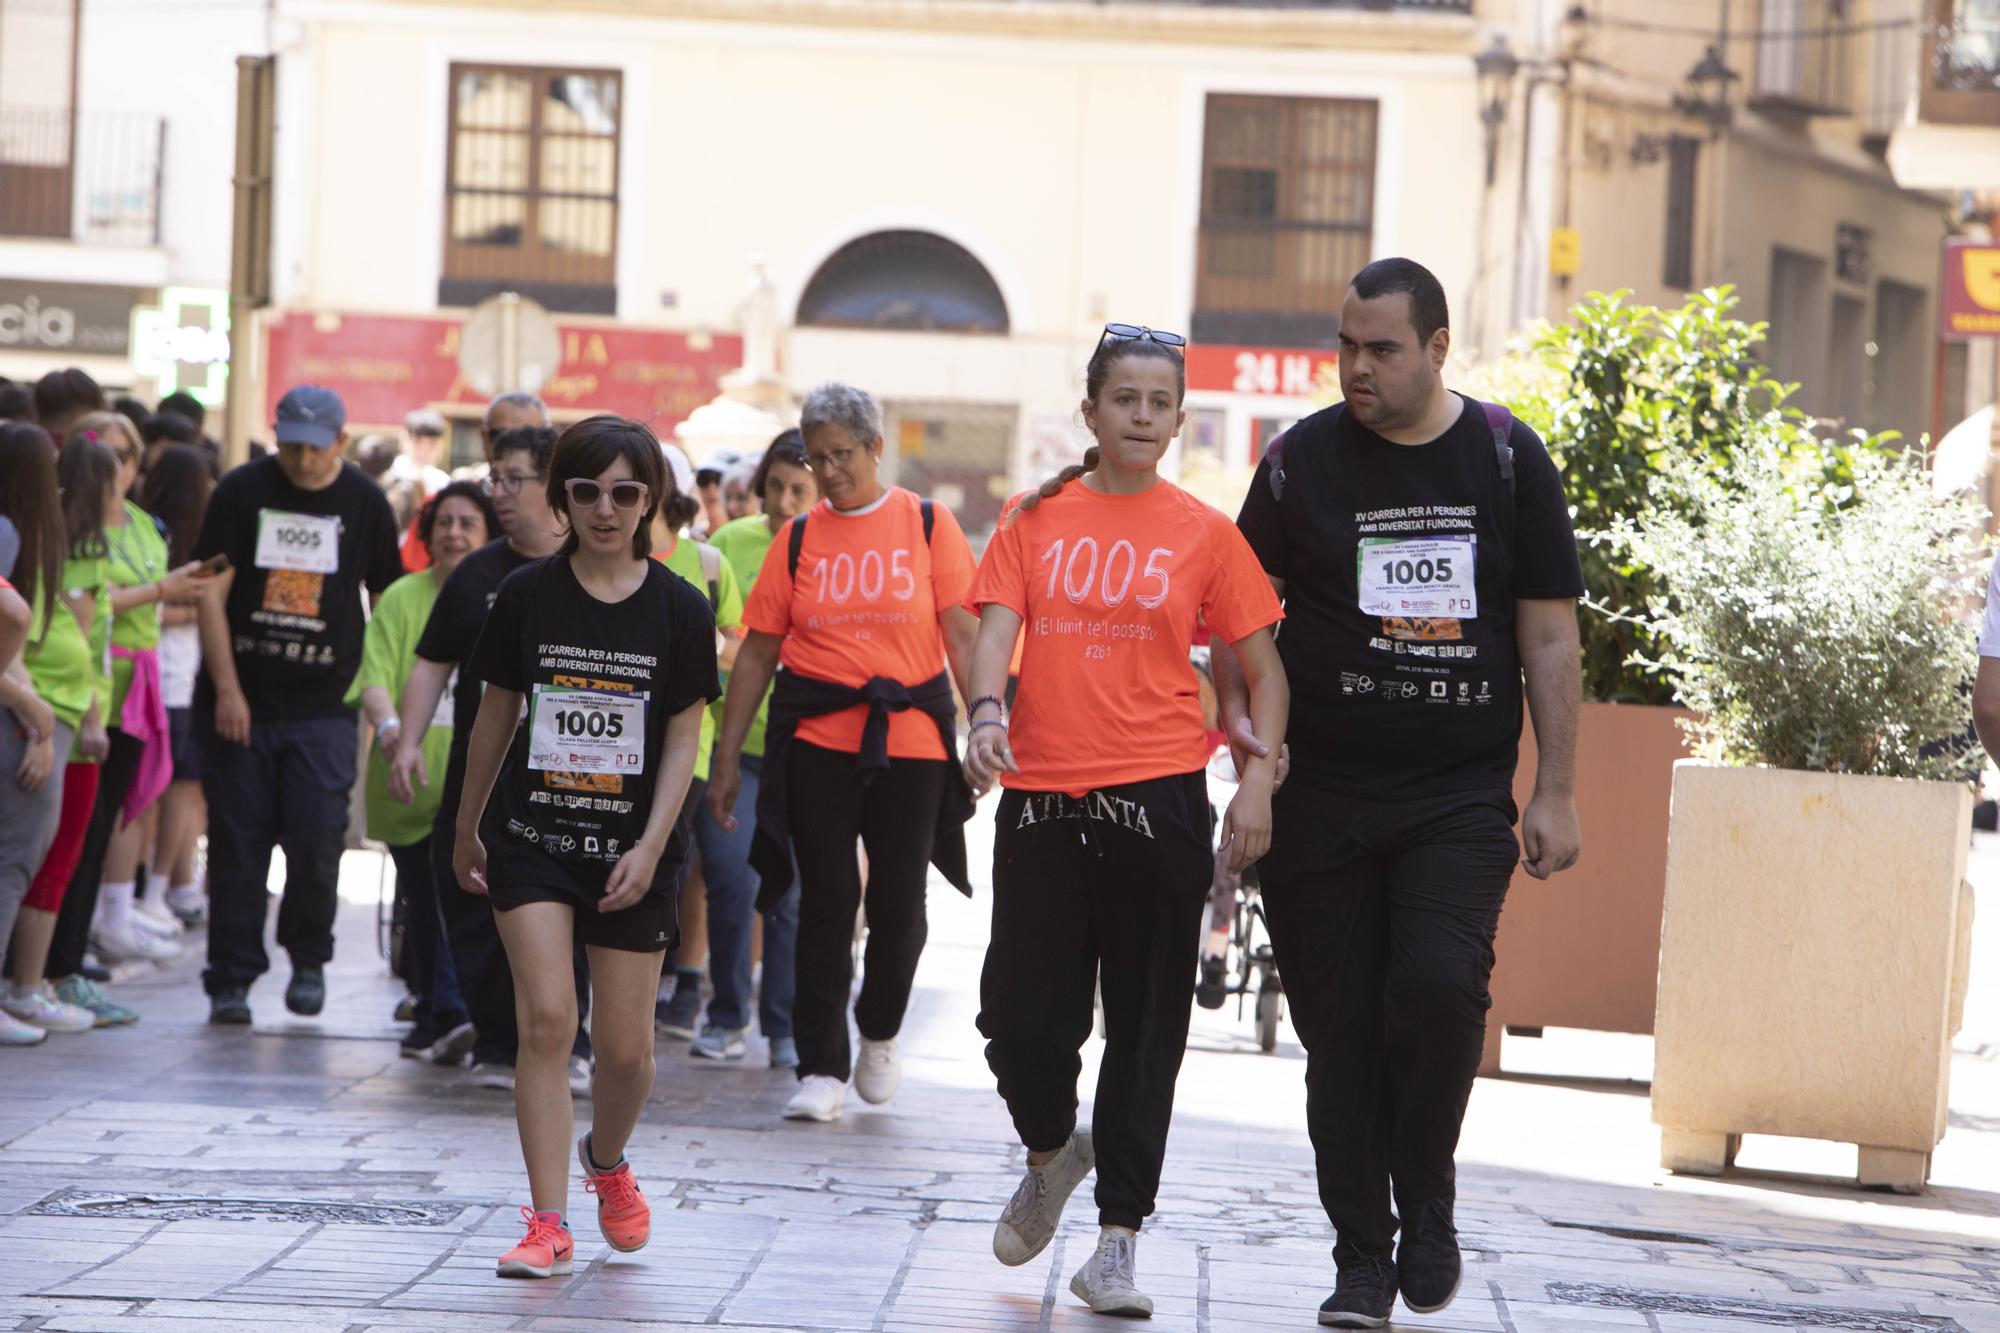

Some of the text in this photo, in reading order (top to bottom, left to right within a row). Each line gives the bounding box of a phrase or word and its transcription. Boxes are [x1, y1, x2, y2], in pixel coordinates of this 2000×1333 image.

[1355, 505, 1477, 522] XV CARRERA PER A PERSONES
[1358, 518, 1474, 533] AMB DIVERSITAT FUNCIONAL
[276, 527, 322, 550] 1005
[812, 548, 916, 604] 1005
[1041, 536, 1174, 609] 1005
[1382, 558, 1453, 584] 1005
[538, 644, 657, 667] XV CARRERA PER A PERSONES
[540, 657, 652, 679] AMB DIVERSITAT FUNCIONAL
[555, 710, 624, 738] 1005
